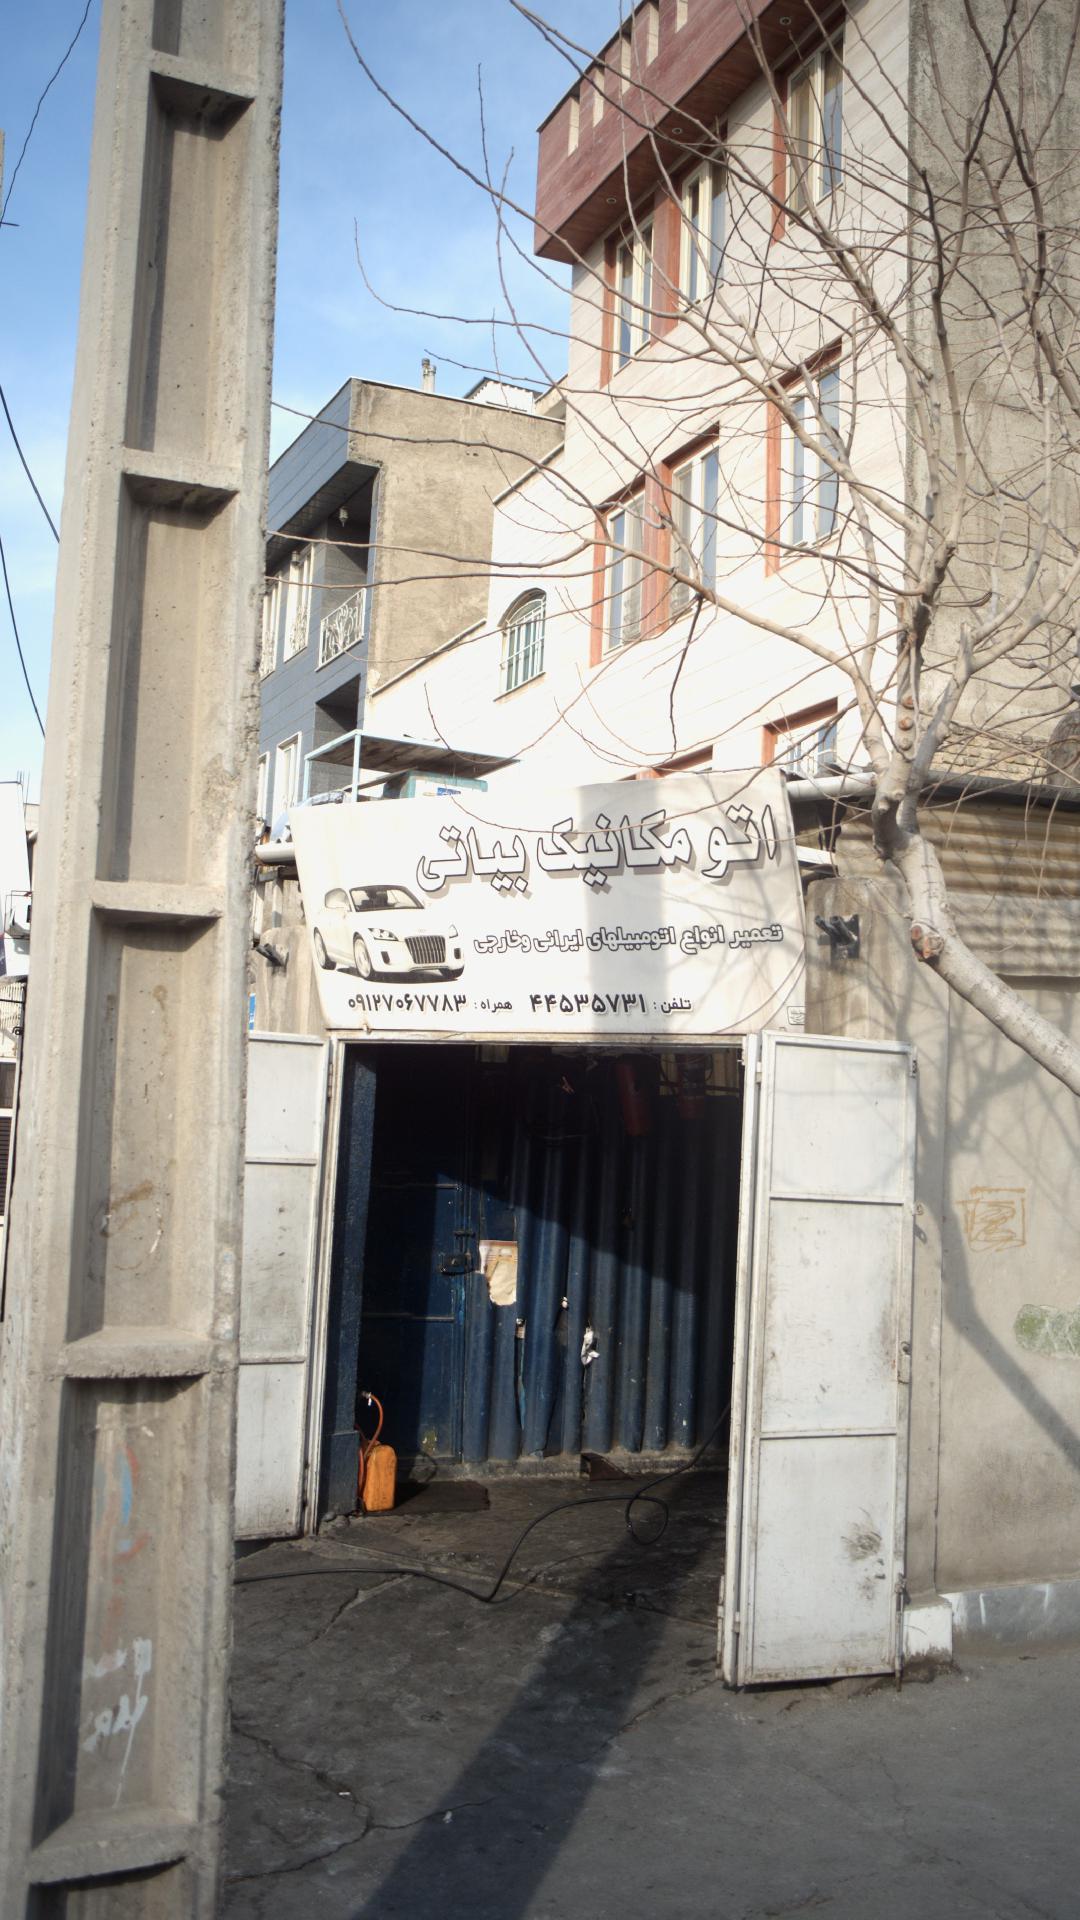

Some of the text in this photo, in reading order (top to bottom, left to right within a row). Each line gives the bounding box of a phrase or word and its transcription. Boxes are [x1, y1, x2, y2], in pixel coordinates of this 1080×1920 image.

[416, 803, 777, 893] اتو مکانیک بیاتی
[533, 928, 584, 953] ایرانی
[586, 925, 676, 951] اتومبیلهای
[679, 924, 725, 955] انواع
[728, 924, 784, 949] تعمیر
[348, 993, 467, 1013] ۰۹۱۲۷۰۶۷۷۸۳
[529, 993, 646, 1013] ۴۴۵۳۵۷۳۱
